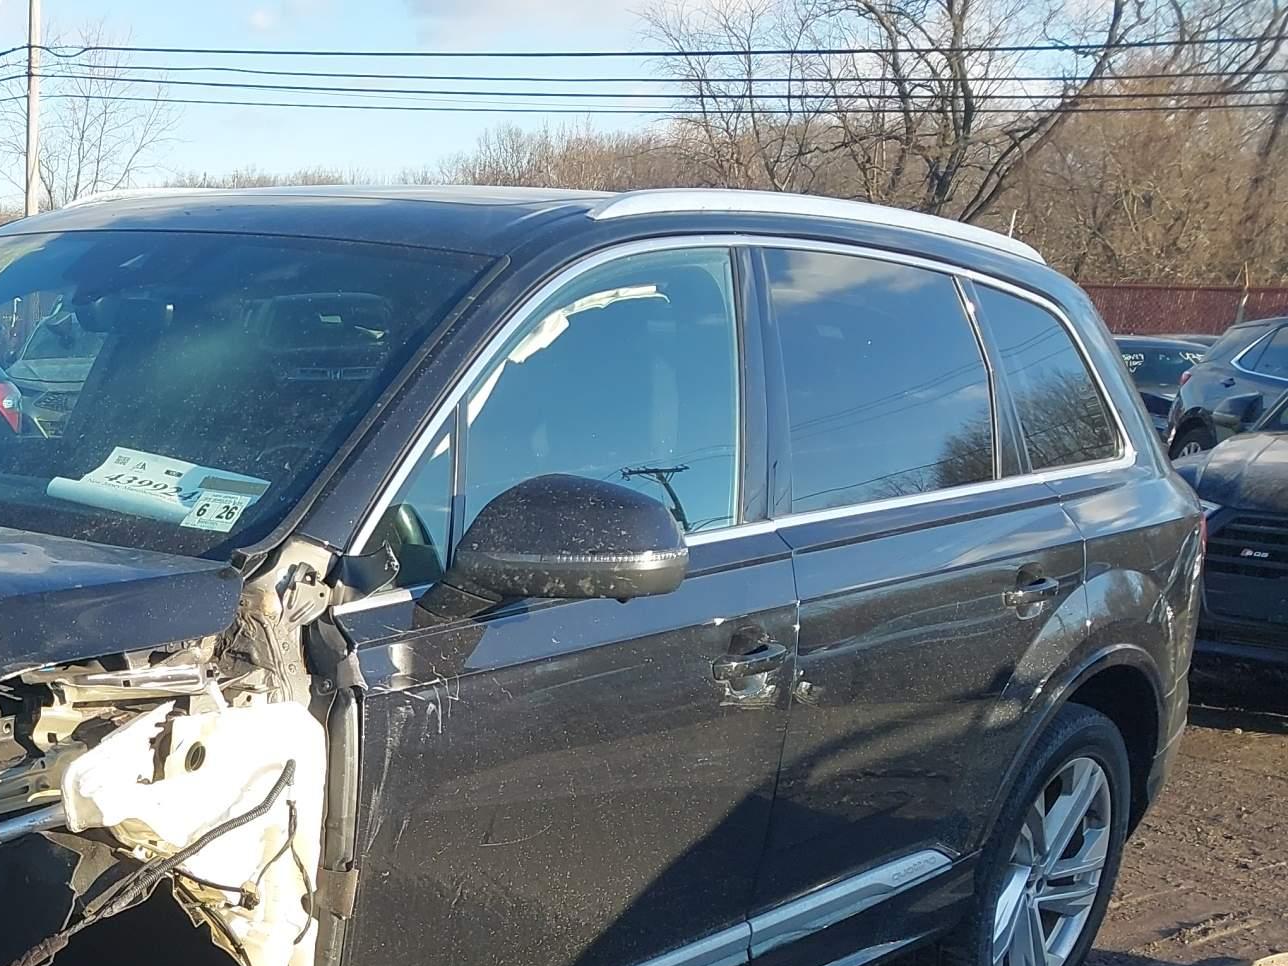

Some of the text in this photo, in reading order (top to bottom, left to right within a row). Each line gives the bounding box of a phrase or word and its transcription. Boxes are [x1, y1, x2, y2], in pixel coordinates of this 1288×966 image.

[104, 473, 201, 501] 439924
[196, 503, 238, 520] 6 26
